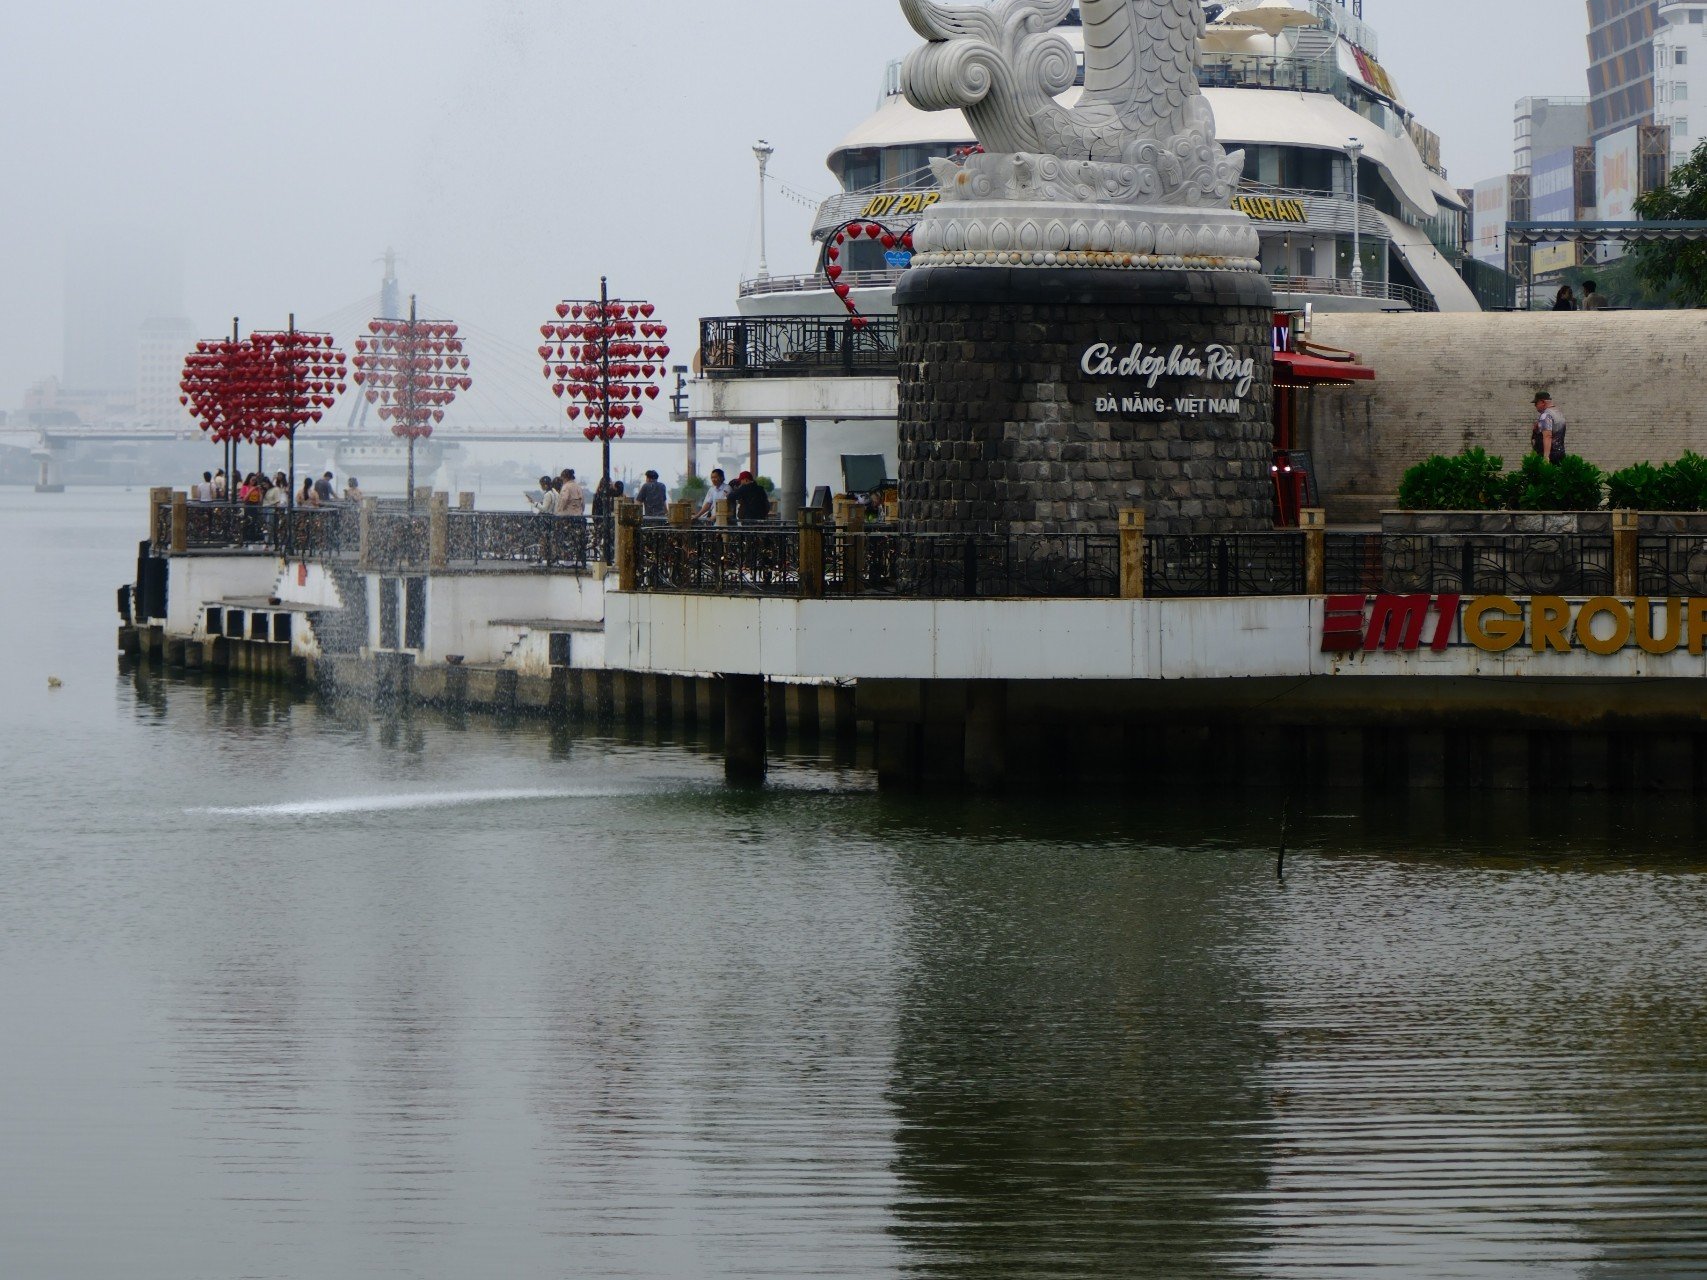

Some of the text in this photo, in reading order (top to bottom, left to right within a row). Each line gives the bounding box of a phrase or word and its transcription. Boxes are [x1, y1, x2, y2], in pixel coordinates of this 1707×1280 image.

[861, 194, 899, 217] JOY
[1081, 342, 1255, 397] Cá chép hóa Rồng
[1095, 392, 1118, 413] ĐÀ
[1175, 393, 1206, 418] VIỆT
[1208, 398, 1240, 414] NAM
